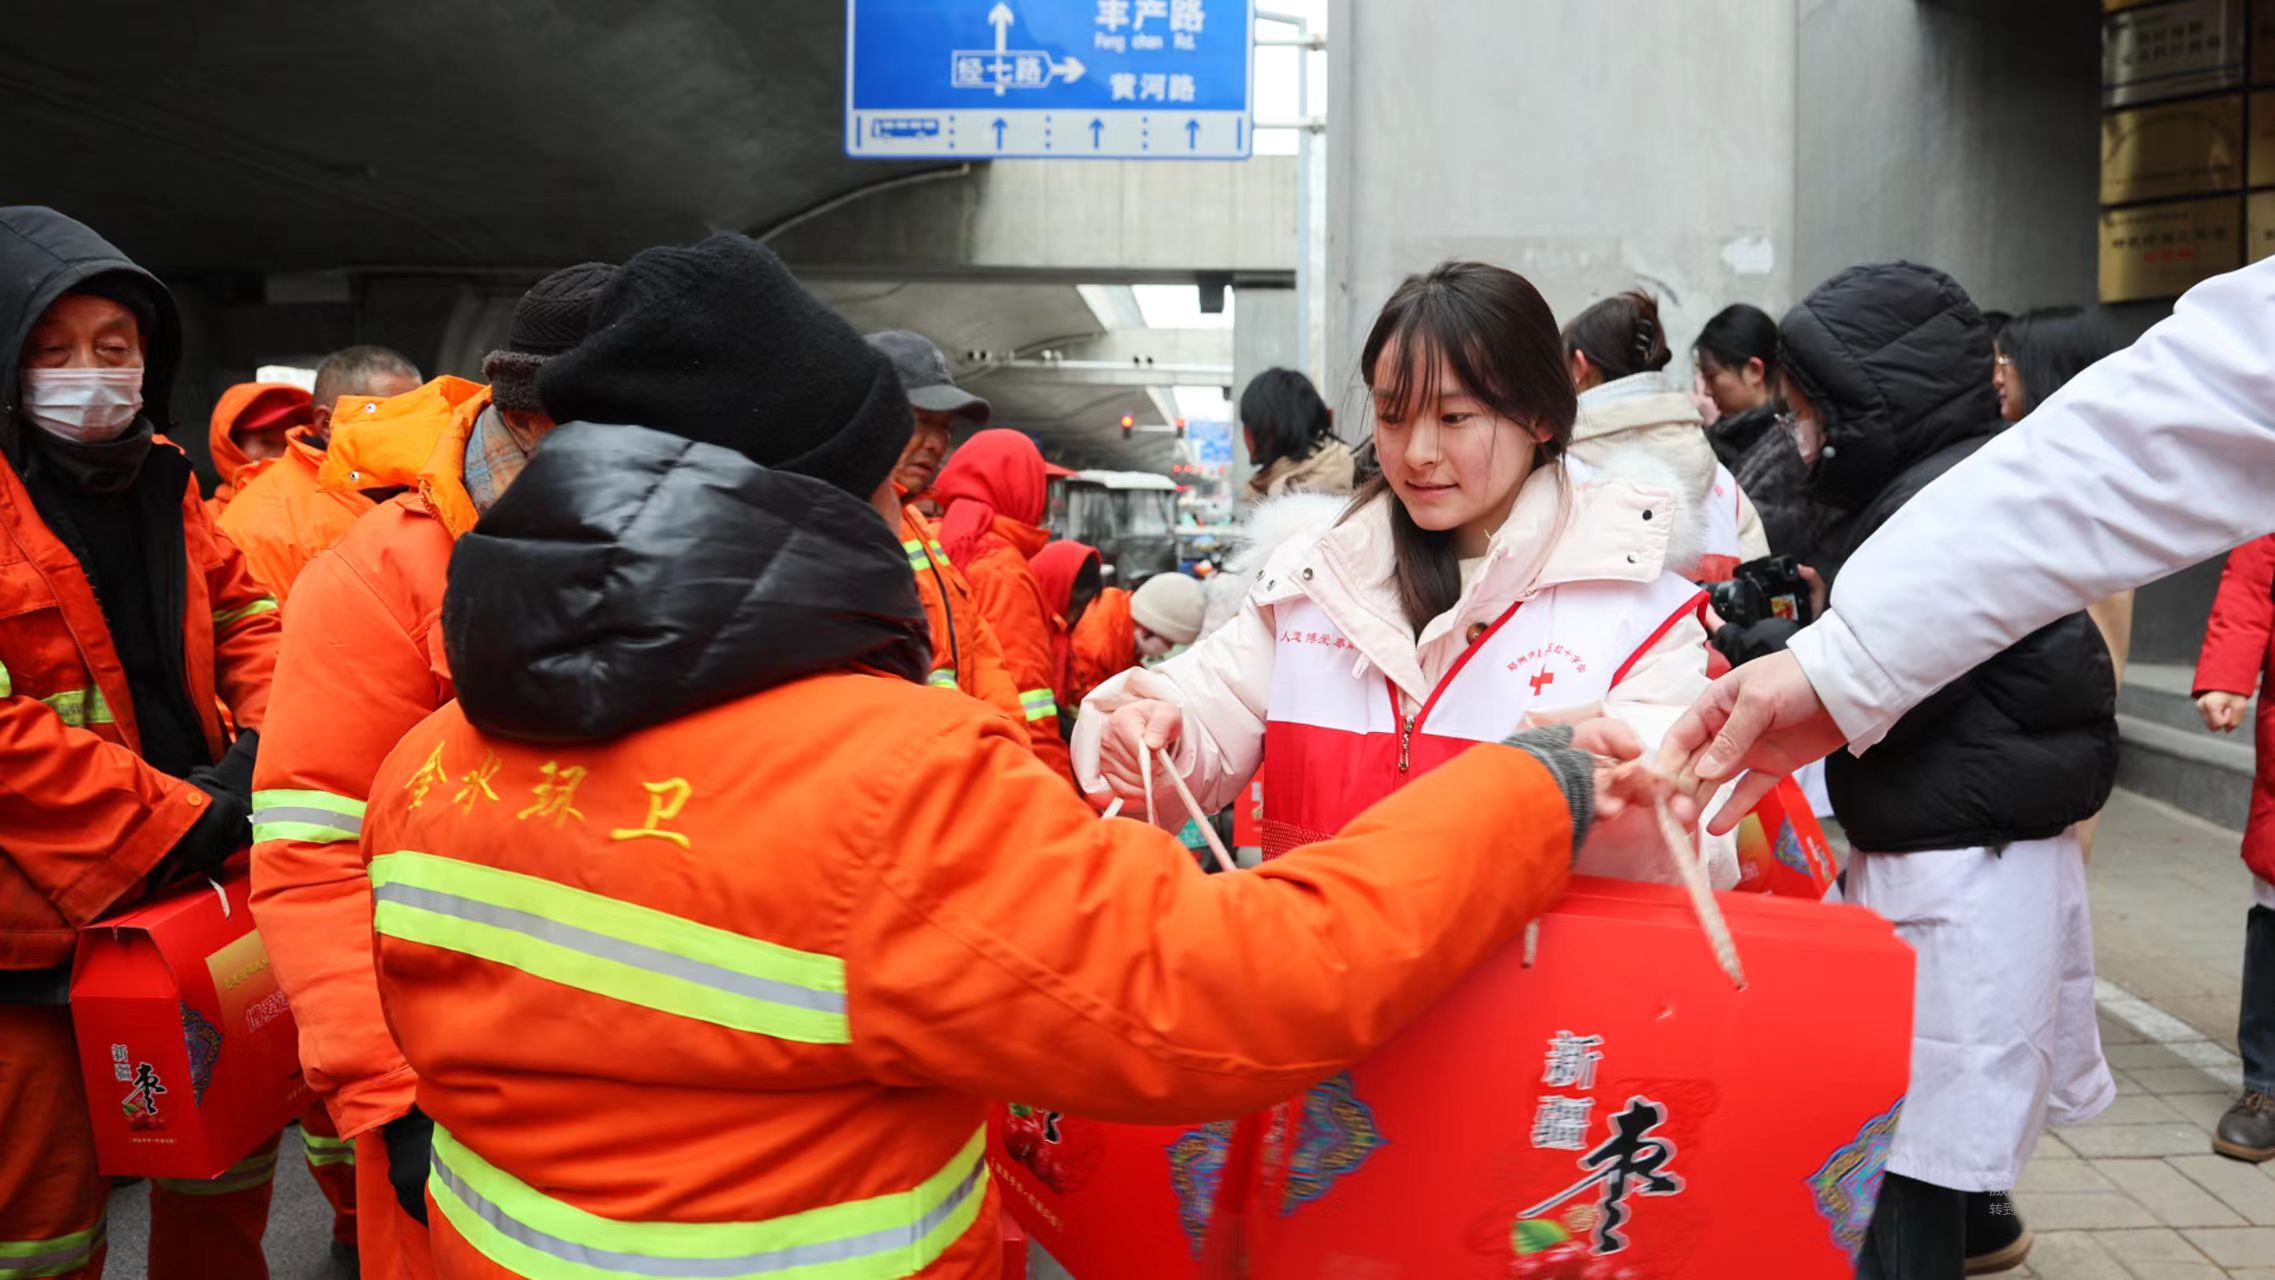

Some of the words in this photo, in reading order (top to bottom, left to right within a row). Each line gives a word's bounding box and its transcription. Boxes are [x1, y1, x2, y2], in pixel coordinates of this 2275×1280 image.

[1094, 0, 1206, 32] 丰产路
[957, 57, 1043, 84] 经七路
[1109, 72, 1197, 103] 黄河路
[403, 740, 692, 849] 金水环卫
[111, 1043, 132, 1082] 新疆
[122, 1062, 167, 1115] 枣
[1531, 1030, 1605, 1150] 新疆
[1516, 1095, 1686, 1256] 枣
